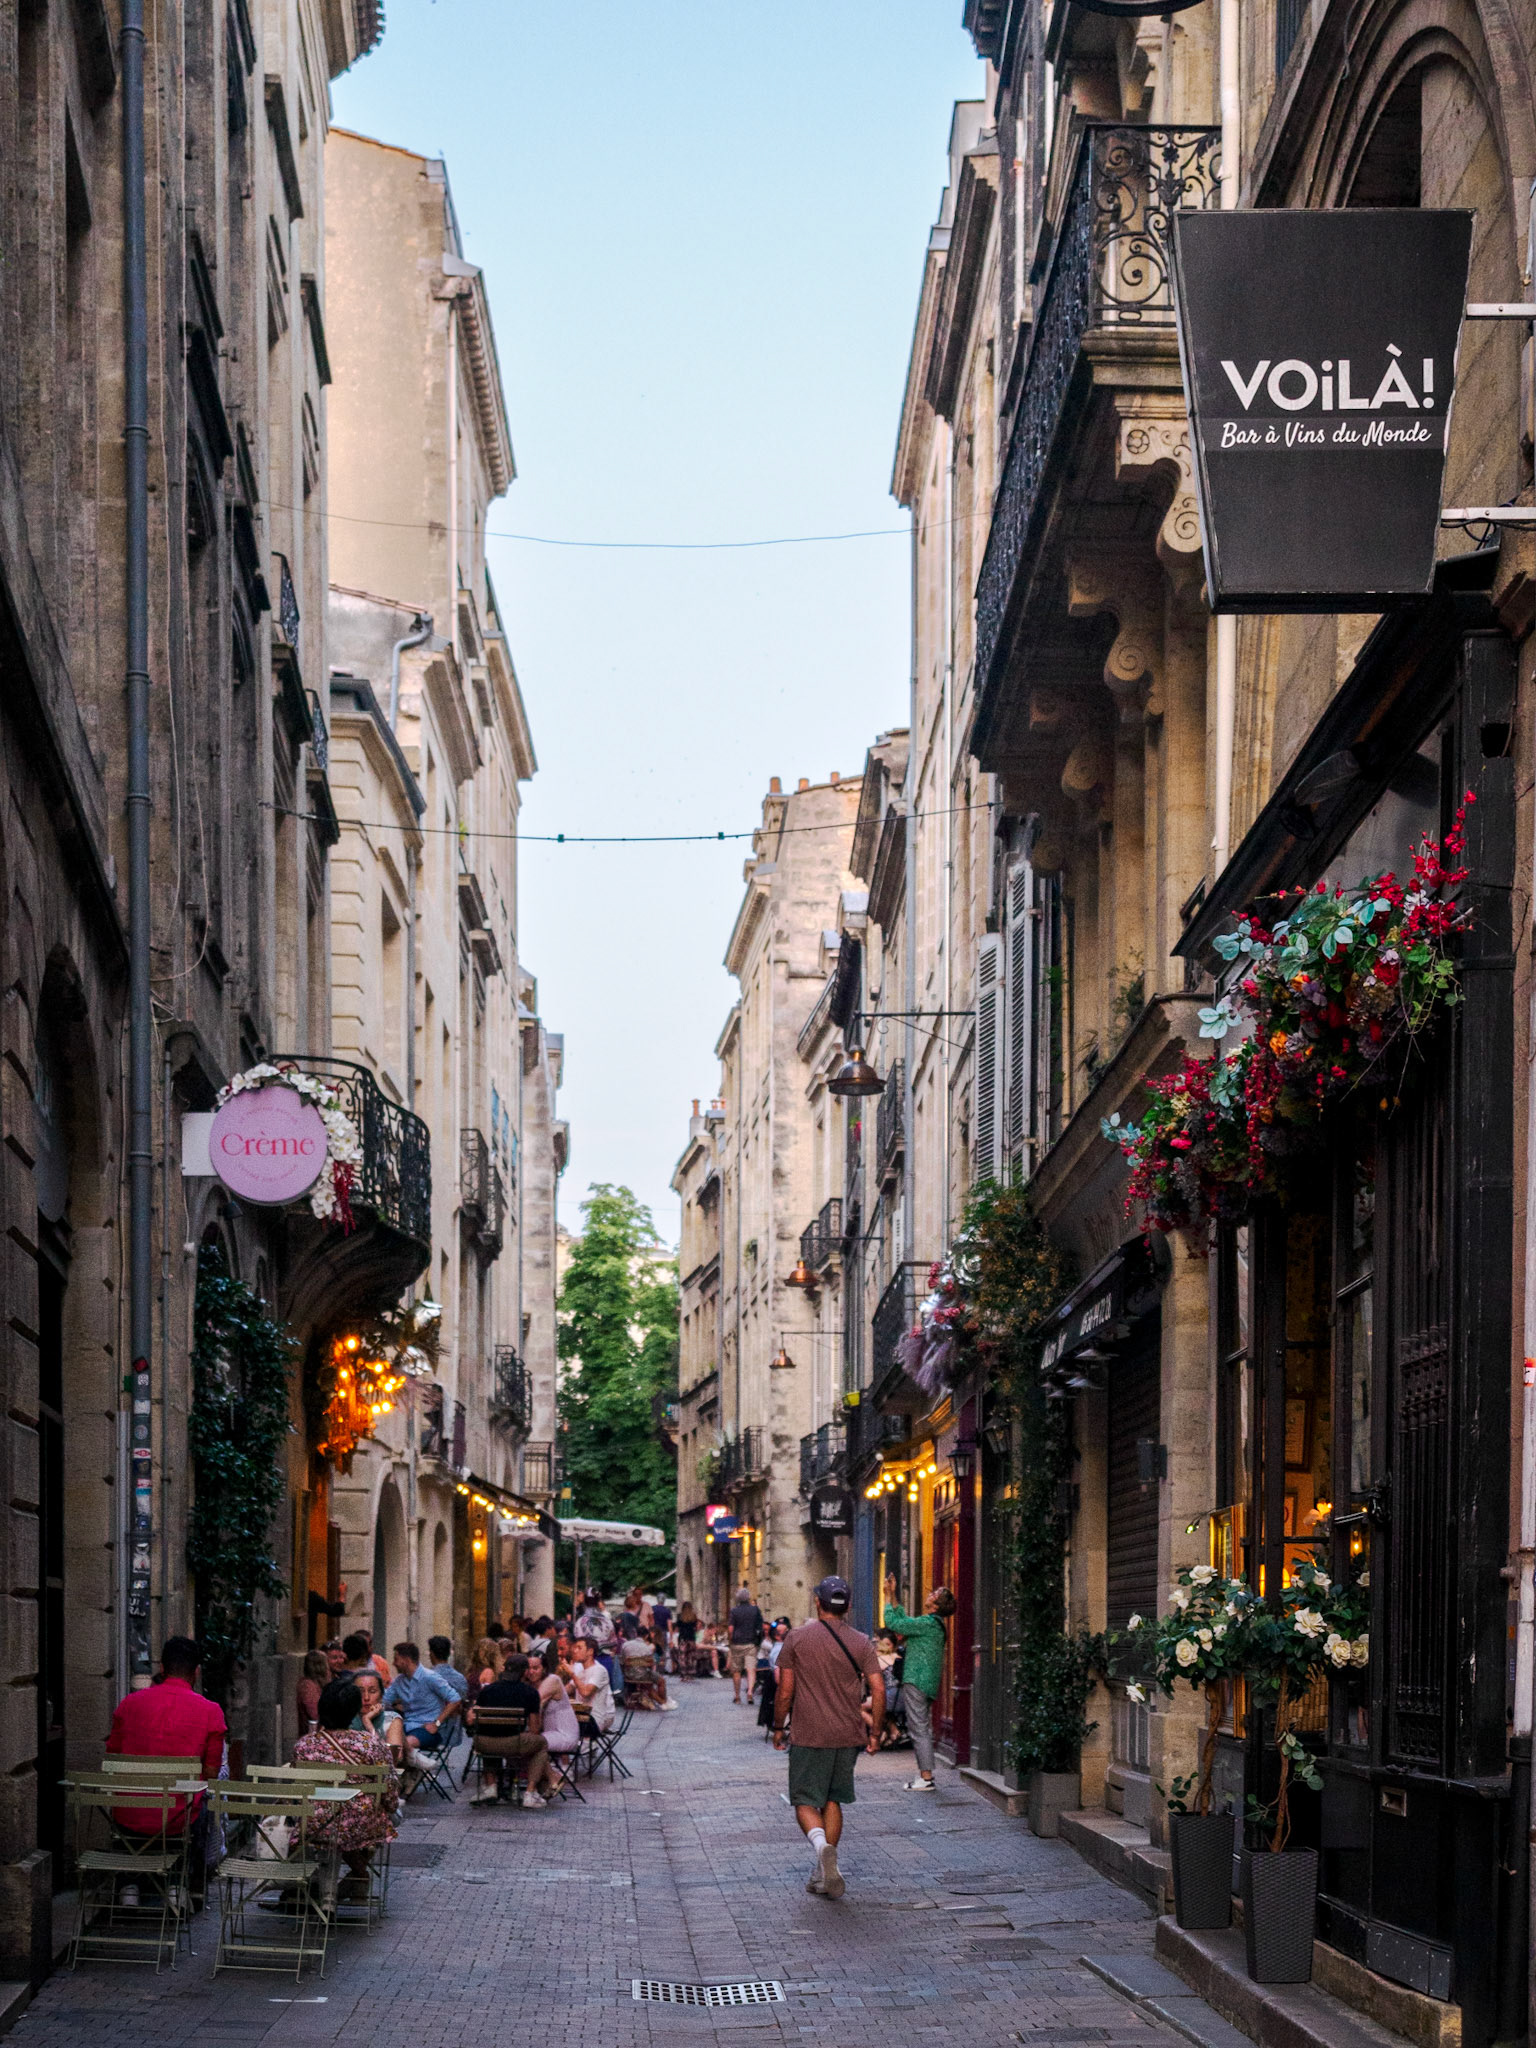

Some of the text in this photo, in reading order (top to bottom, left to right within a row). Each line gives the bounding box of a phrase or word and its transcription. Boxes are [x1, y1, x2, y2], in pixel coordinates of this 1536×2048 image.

[1221, 420, 1432, 448] Bar à Vins du Monde
[220, 1130, 316, 1157] Crème
